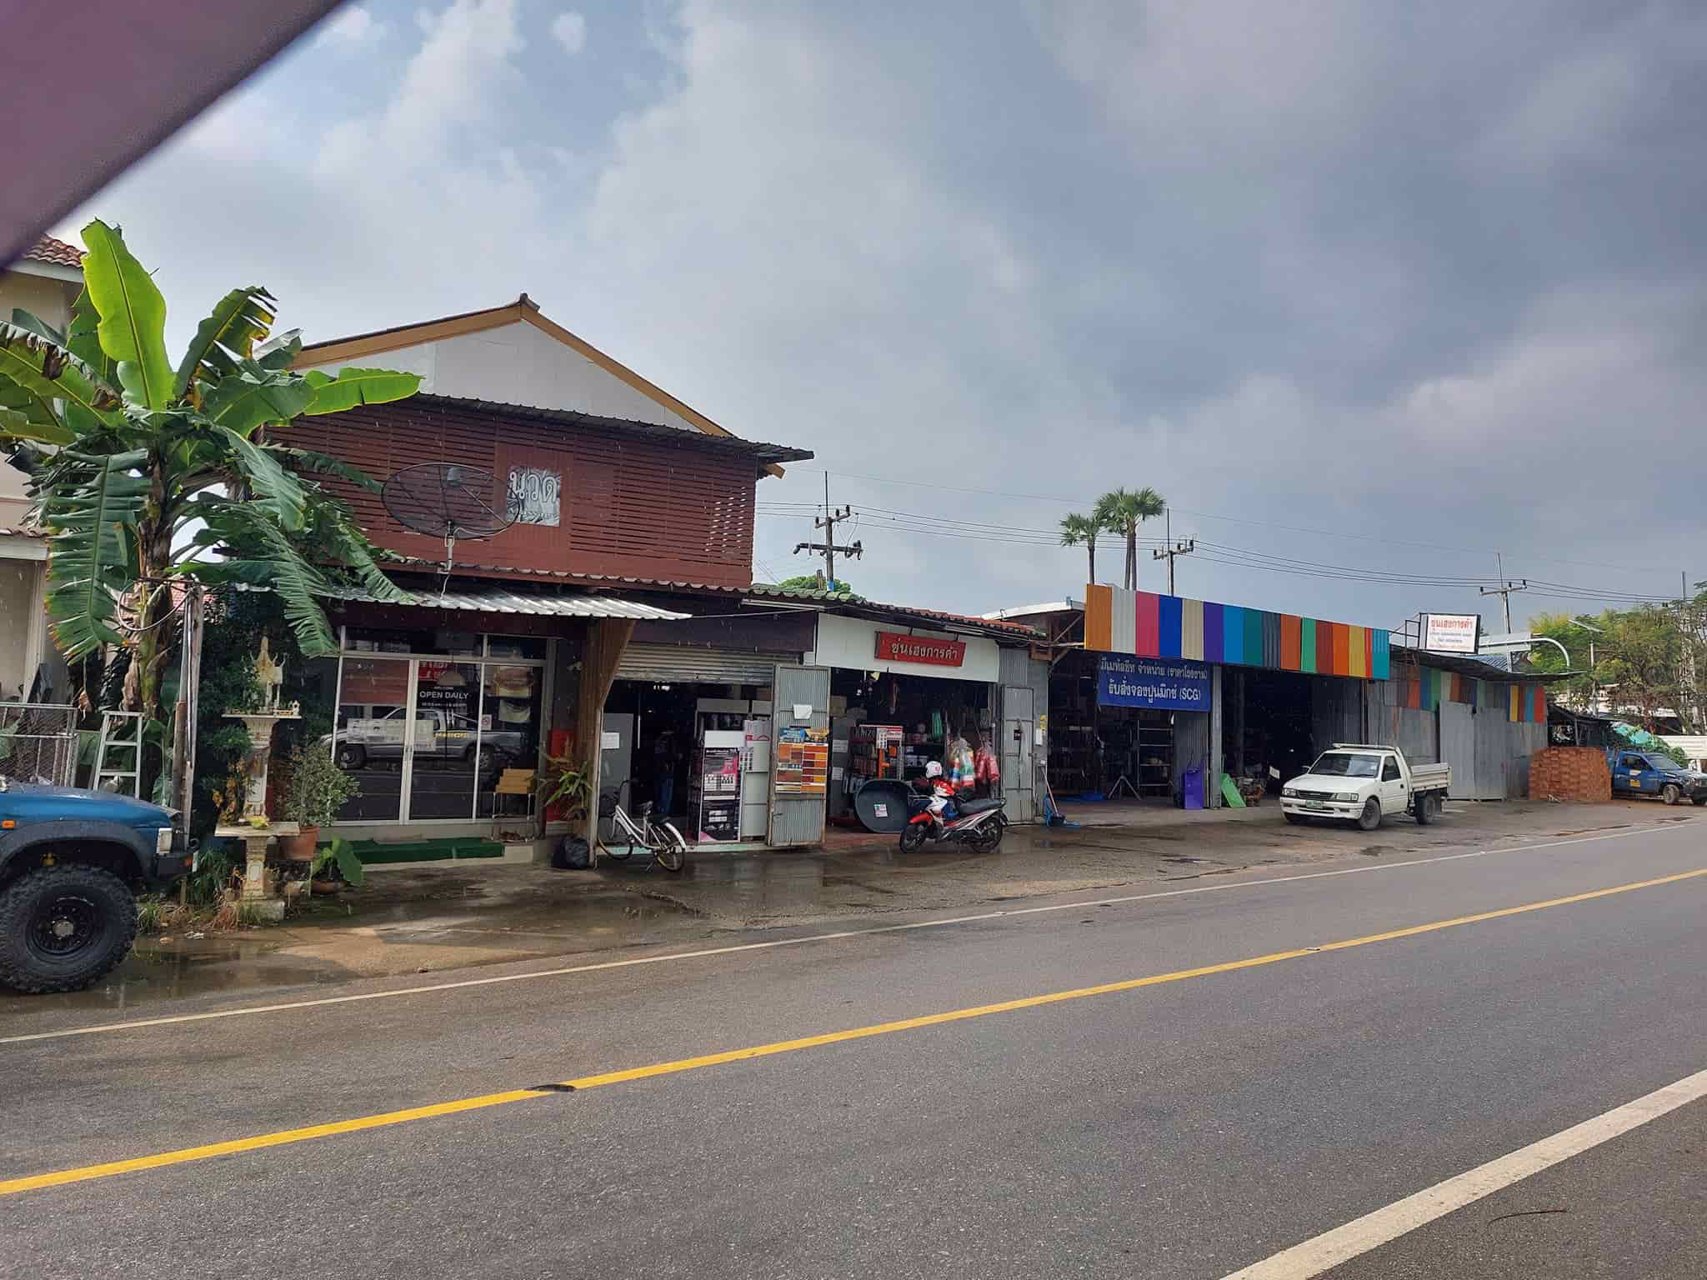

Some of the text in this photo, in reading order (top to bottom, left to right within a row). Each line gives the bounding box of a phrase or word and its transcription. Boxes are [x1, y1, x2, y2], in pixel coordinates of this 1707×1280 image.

[509, 471, 558, 503] นวด
[1137, 661, 1166, 676] จำหน่าย
[419, 690, 469, 700] OPEN DAILY
[1179, 687, 1202, 701] (SCG)
